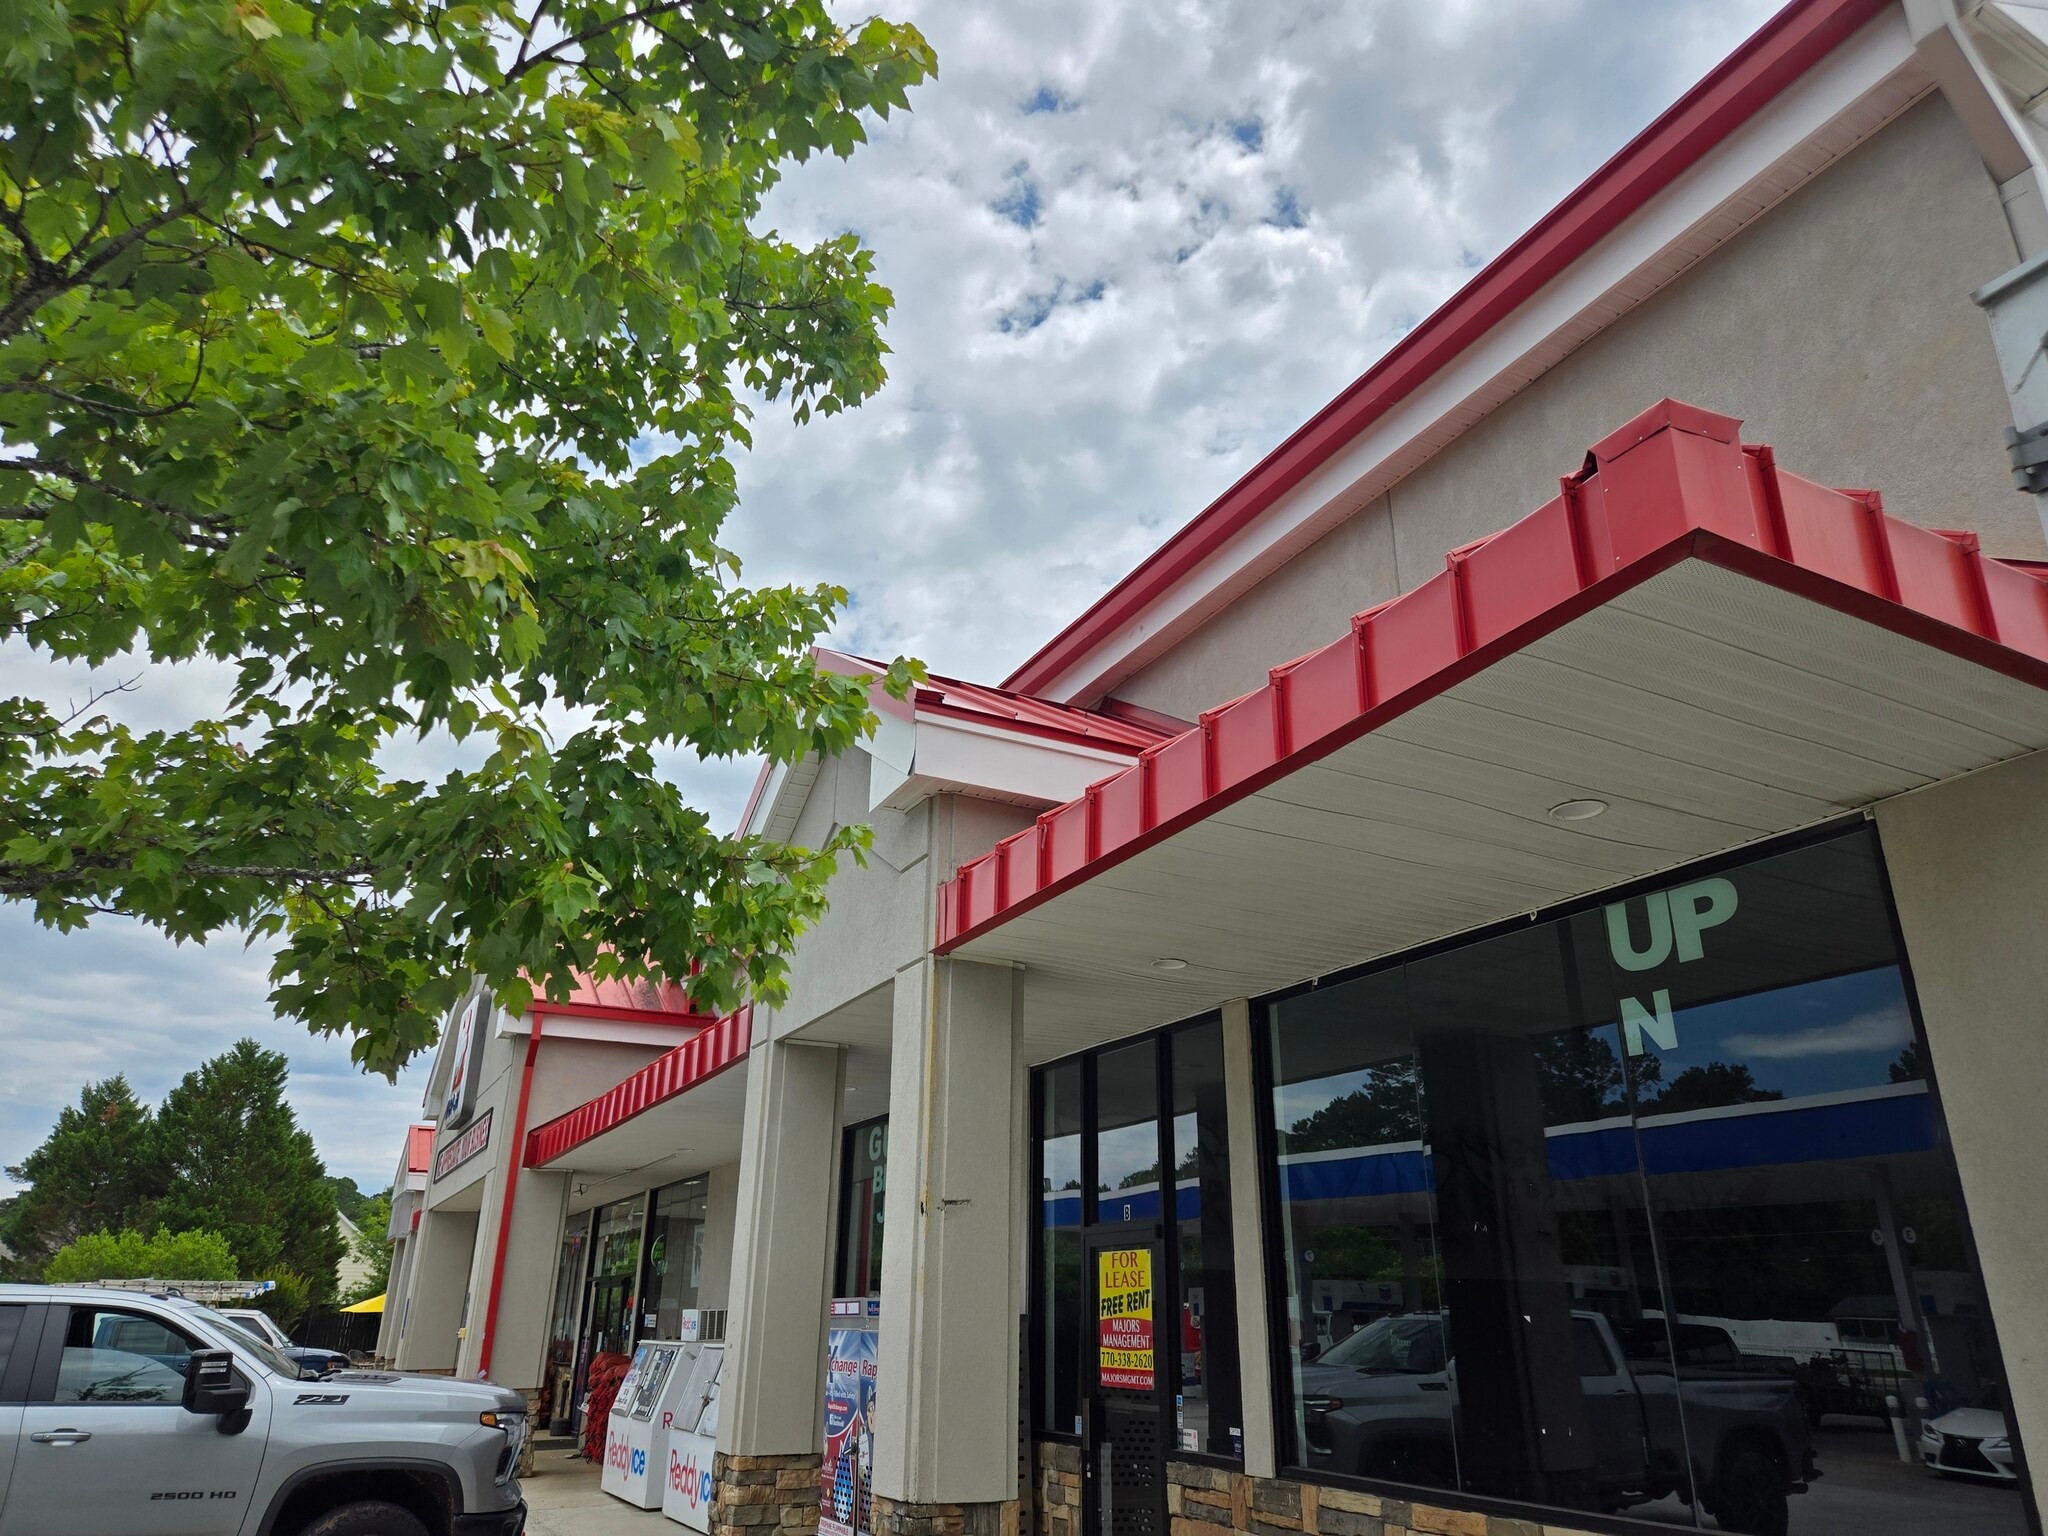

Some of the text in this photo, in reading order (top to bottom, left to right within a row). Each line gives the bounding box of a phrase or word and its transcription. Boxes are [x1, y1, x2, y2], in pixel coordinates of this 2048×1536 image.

[1605, 878, 1738, 971] UP
[1620, 989, 1679, 1056] N
[1112, 1252, 1139, 1268] FOR
[1105, 1270, 1145, 1288] LEASE
[1101, 1289, 1150, 1317] FREE RENT
[1112, 1319, 1140, 1333] MAJORS
[1102, 1334, 1150, 1349] MANAGEMENT
[1101, 1351, 1153, 1369] 770-338-2620
[1101, 1373, 1153, 1386] MAJORSMGMT.COM
[607, 1430, 631, 1482] Reddy
[669, 1448, 702, 1510] Reddy
[151, 1491, 237, 1501] 2500 HD
